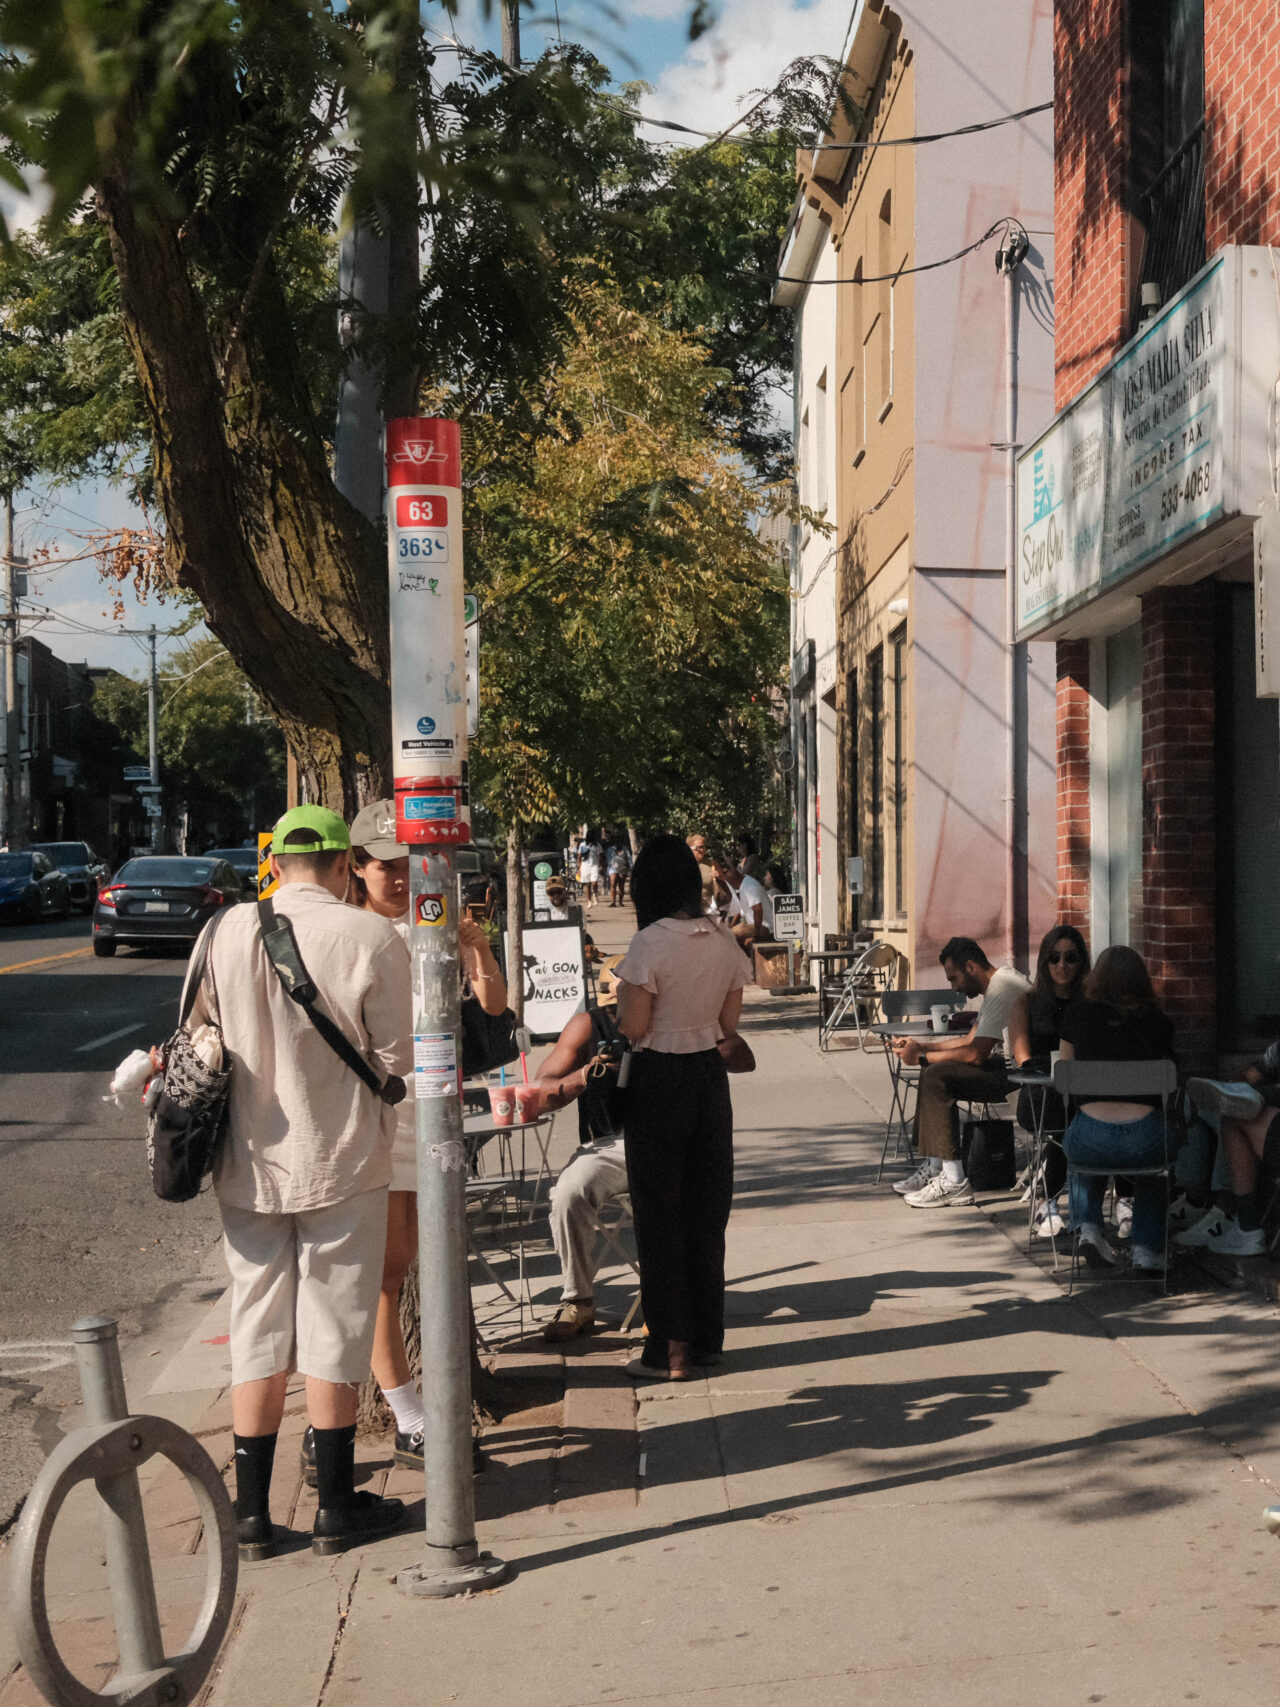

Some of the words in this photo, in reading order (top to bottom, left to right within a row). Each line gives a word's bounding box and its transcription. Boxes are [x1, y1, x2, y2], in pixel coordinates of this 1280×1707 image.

[1123, 366, 1144, 420] JOSE
[1148, 335, 1181, 395] MARIA
[1184, 305, 1213, 367] SILVA
[1153, 403, 1161, 429] de
[1130, 442, 1175, 490] INCOME
[1182, 422, 1203, 449] TAX
[409, 501, 433, 521] 63
[1161, 462, 1210, 521] 533-4068
[400, 538, 433, 557] 363
[1023, 534, 1046, 587] Step
[1047, 514, 1064, 573] One
[552, 962, 579, 974] GON
